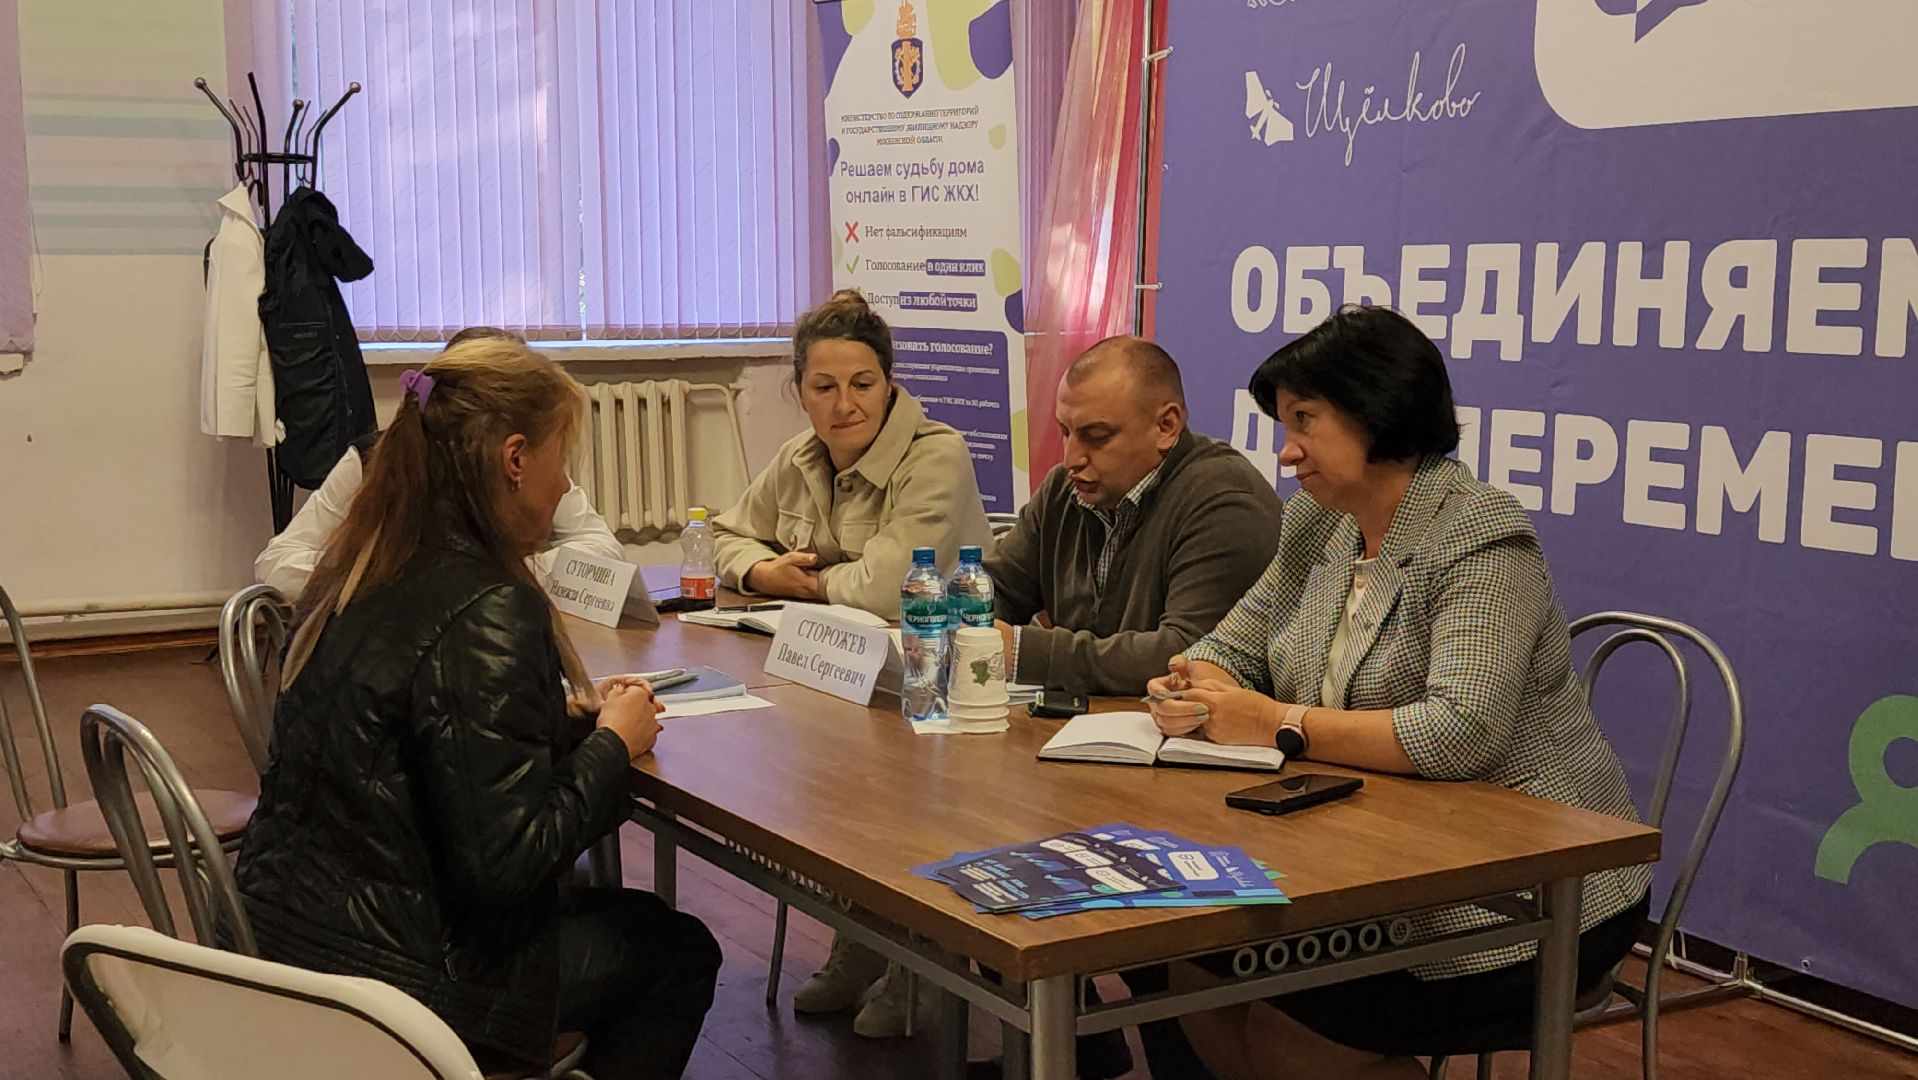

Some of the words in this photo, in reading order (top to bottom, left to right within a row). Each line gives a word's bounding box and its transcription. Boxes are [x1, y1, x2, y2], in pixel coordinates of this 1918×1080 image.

[840, 161, 892, 177] Решаем
[896, 157, 944, 180] судьбу
[948, 160, 984, 177] дома
[846, 187, 895, 203] онлайн
[899, 190, 906, 202] в
[911, 185, 940, 203] ГИС
[944, 184, 979, 202] ЖКХ!
[865, 225, 884, 237] Нет
[885, 224, 968, 241] фальсификациям
[927, 262, 934, 272] в
[867, 292, 900, 308] Доступ
[913, 292, 948, 306] любой
[1453, 406, 1918, 560] ЕРЕМЕ
[797, 619, 867, 656] СТОРОЖЕВ
[777, 642, 809, 669] Павел
[810, 653, 866, 688] Сергеевич
